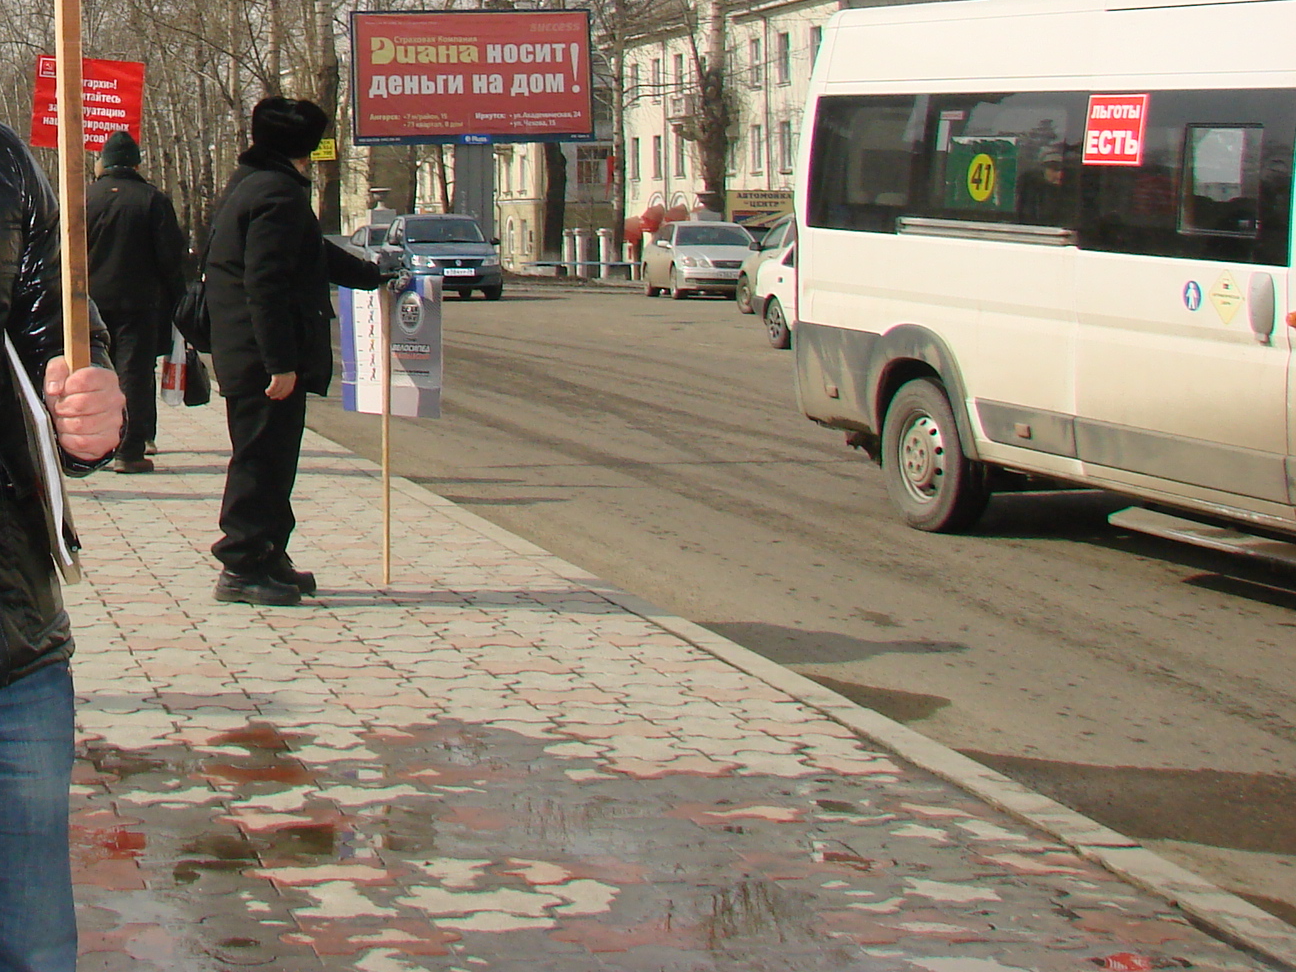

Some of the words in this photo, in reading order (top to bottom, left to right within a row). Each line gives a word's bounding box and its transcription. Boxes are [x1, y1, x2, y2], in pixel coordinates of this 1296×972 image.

[370, 36, 479, 65] Диана
[486, 43, 566, 64] носит
[368, 74, 464, 99] деньги
[472, 74, 504, 94] на
[1090, 104, 1141, 120] ЛЬГОТЫ
[1085, 130, 1139, 155] ЕСТЬ
[969, 162, 992, 191] 41
